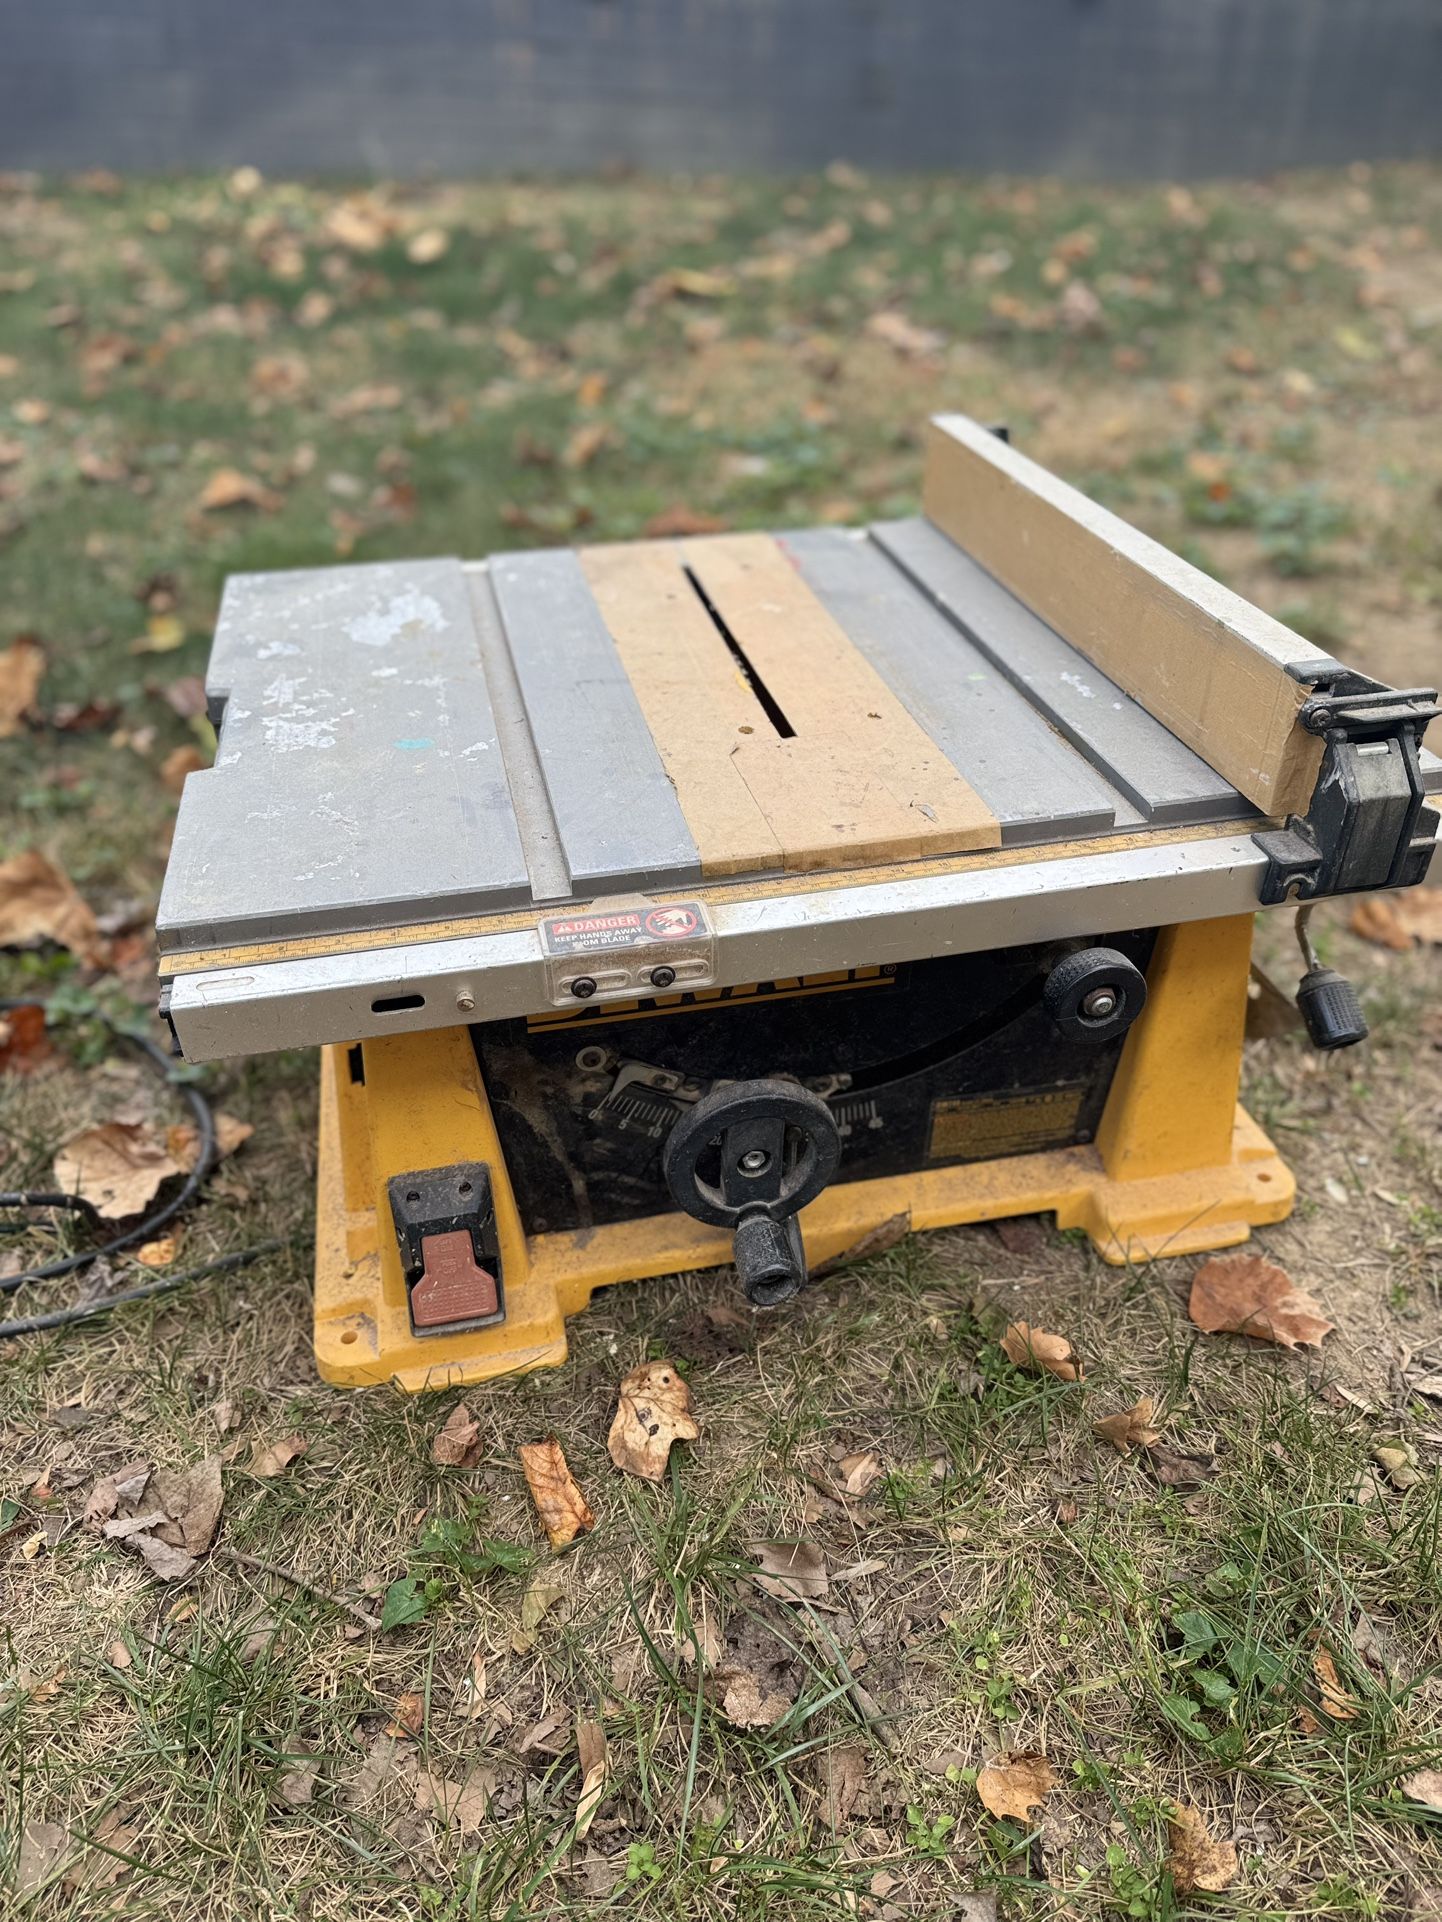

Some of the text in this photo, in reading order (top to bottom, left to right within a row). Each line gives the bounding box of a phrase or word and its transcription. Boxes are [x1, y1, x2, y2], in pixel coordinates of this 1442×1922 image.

[574, 915, 637, 931] DANGER
[554, 926, 642, 943] KEEP HANDS AWAY
[601, 934, 631, 944] BLADE
[618, 1119, 629, 1130] 5
[647, 1126, 662, 1138] 10
